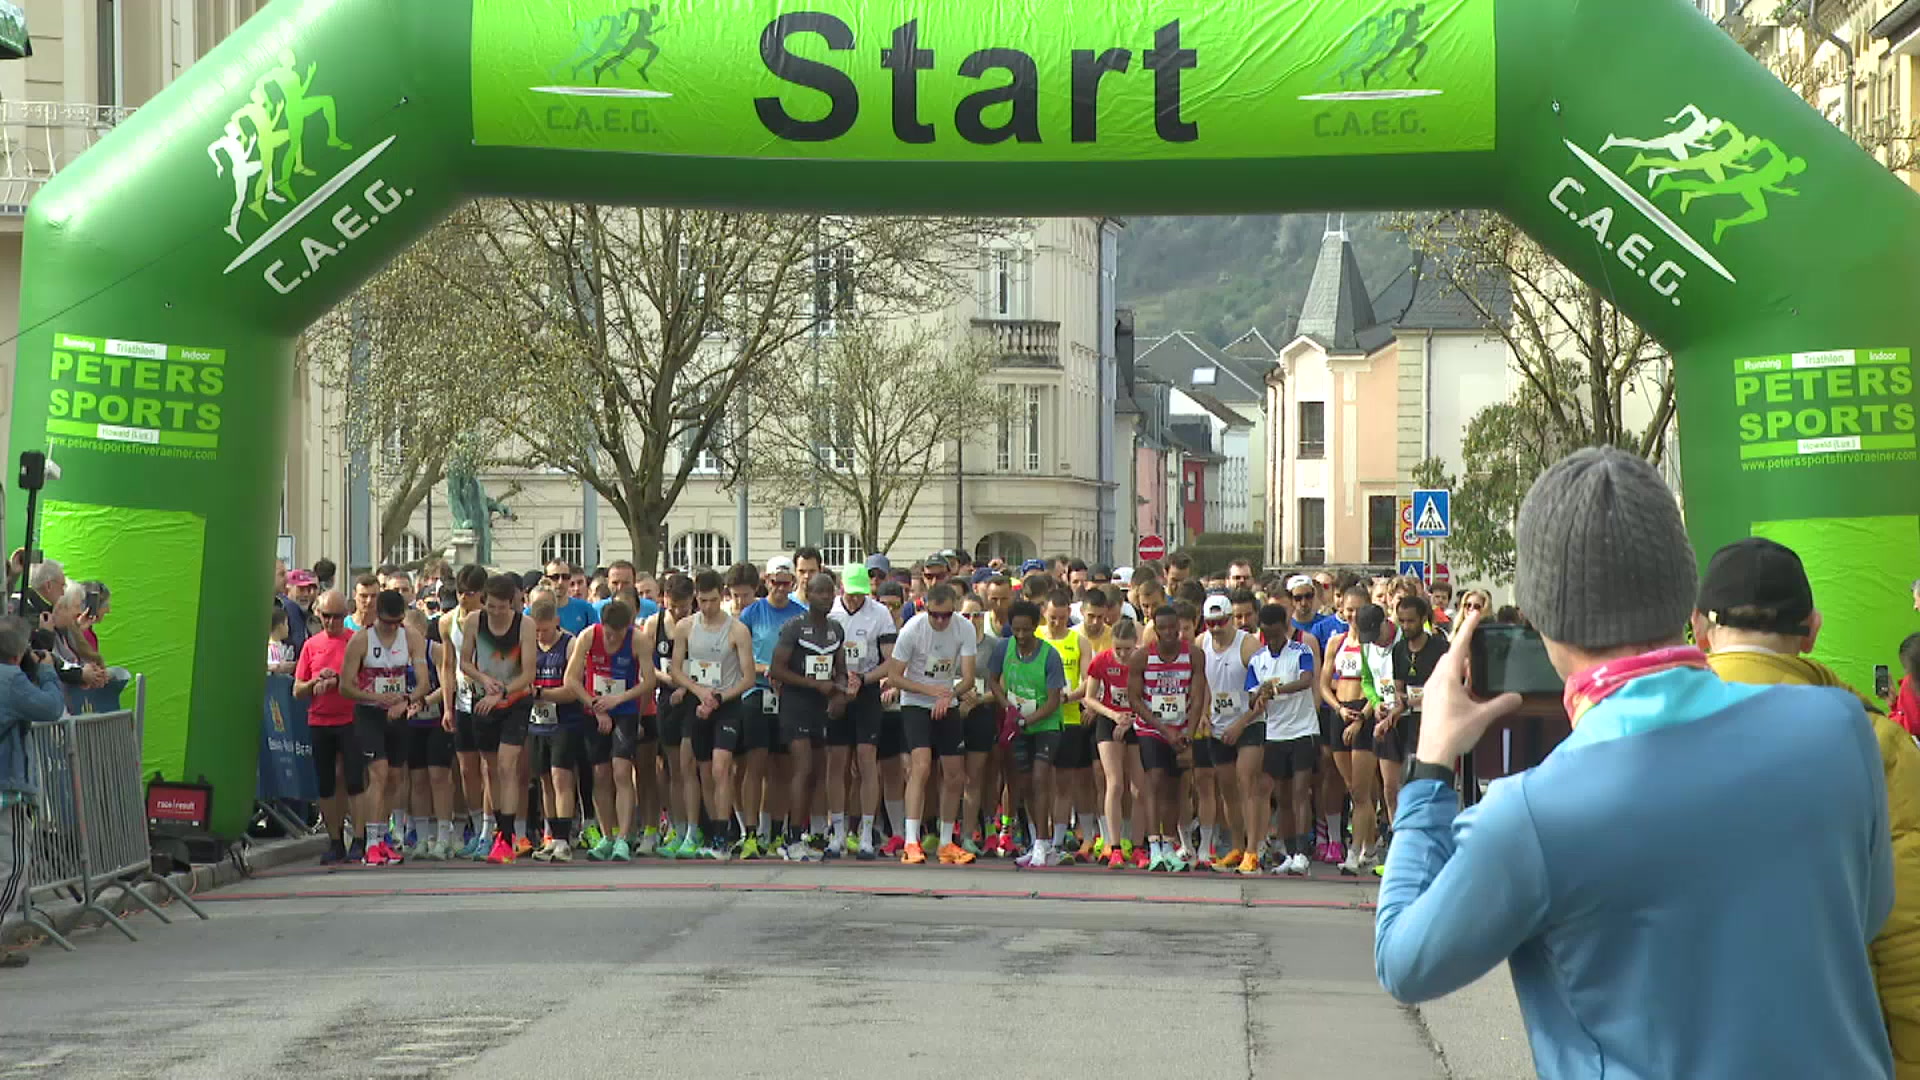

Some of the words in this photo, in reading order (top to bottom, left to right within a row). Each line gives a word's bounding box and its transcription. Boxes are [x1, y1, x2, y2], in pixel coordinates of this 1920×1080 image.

[753, 10, 1198, 144] Start
[546, 104, 658, 134] C.A.E.G.
[1313, 108, 1427, 137] C.A.E.G.
[263, 179, 414, 294] C.A.E.G.
[1548, 176, 1688, 306] C.A.E.G.
[116, 343, 156, 357] Triathlon
[181, 349, 212, 361] Indoor
[1744, 358, 1781, 372] Running
[1804, 354, 1844, 365] Triathlon
[1869, 350, 1897, 361] Indoor
[51, 350, 224, 396] PETERS
[1735, 366, 1913, 406] PETERS
[48, 388, 221, 430] SPORTS
[1739, 403, 1916, 441] SPORTS
[1159, 702, 1178, 712] 475
